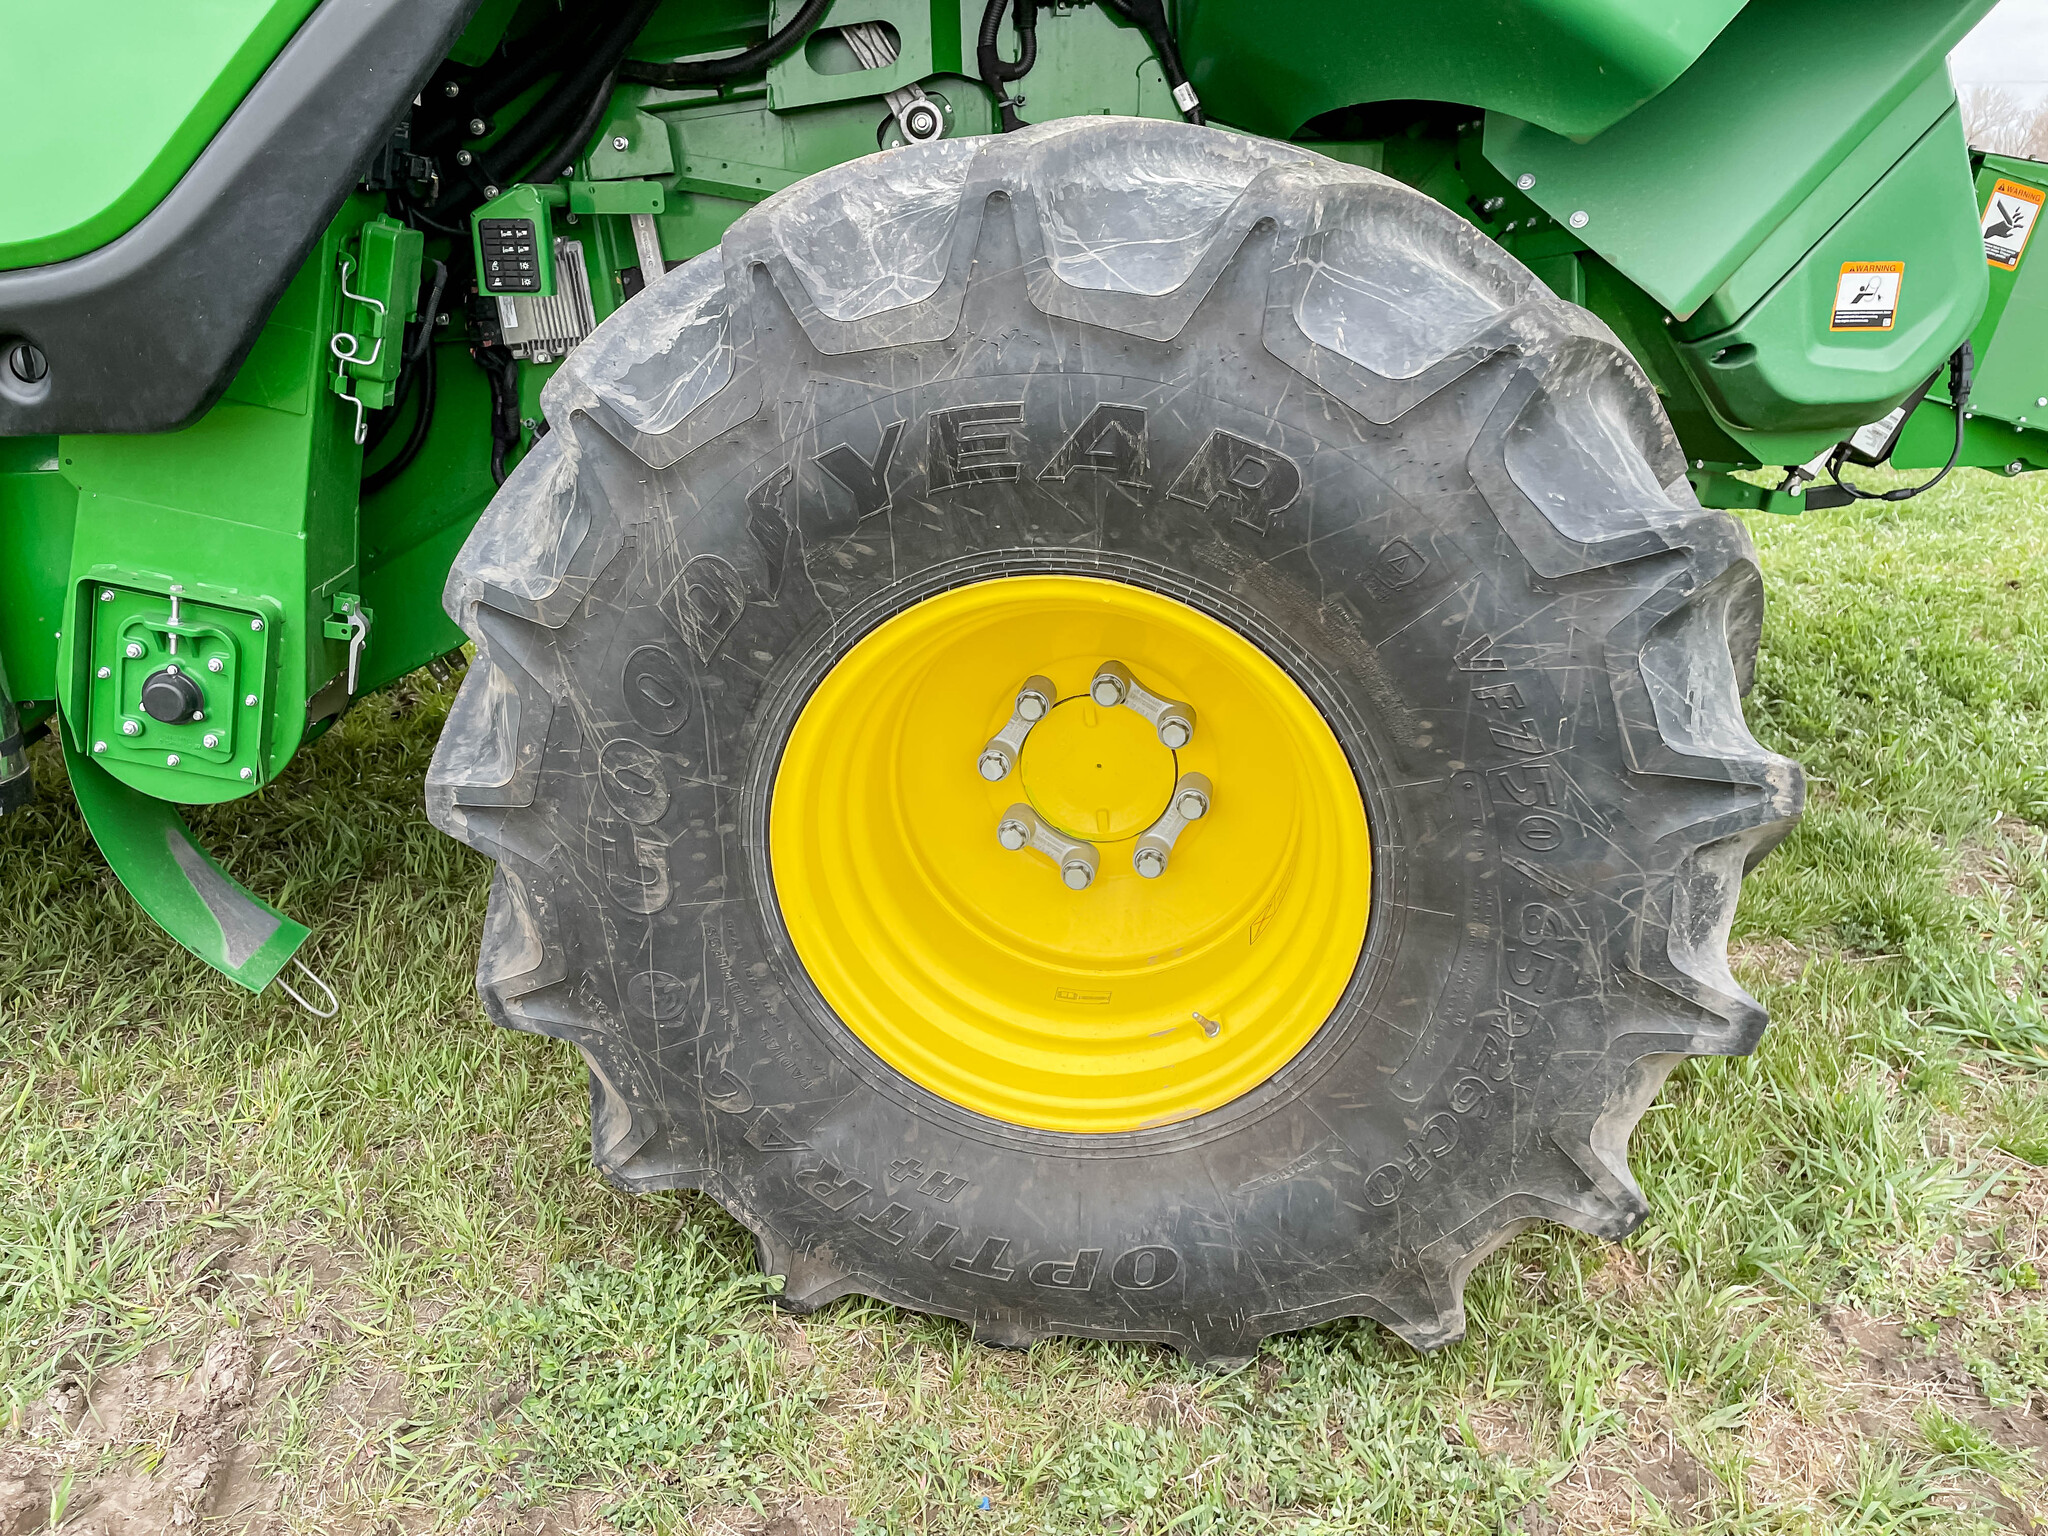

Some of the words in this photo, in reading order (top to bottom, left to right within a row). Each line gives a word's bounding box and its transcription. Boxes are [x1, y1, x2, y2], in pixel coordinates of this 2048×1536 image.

[2007, 184, 2041, 203] WARNING
[1856, 264, 1897, 273] WARNING
[598, 400, 1302, 915] GOODYEAR
[759, 1026, 814, 1092] RADIAL
[700, 1060, 1181, 1291] OPTITRAC
